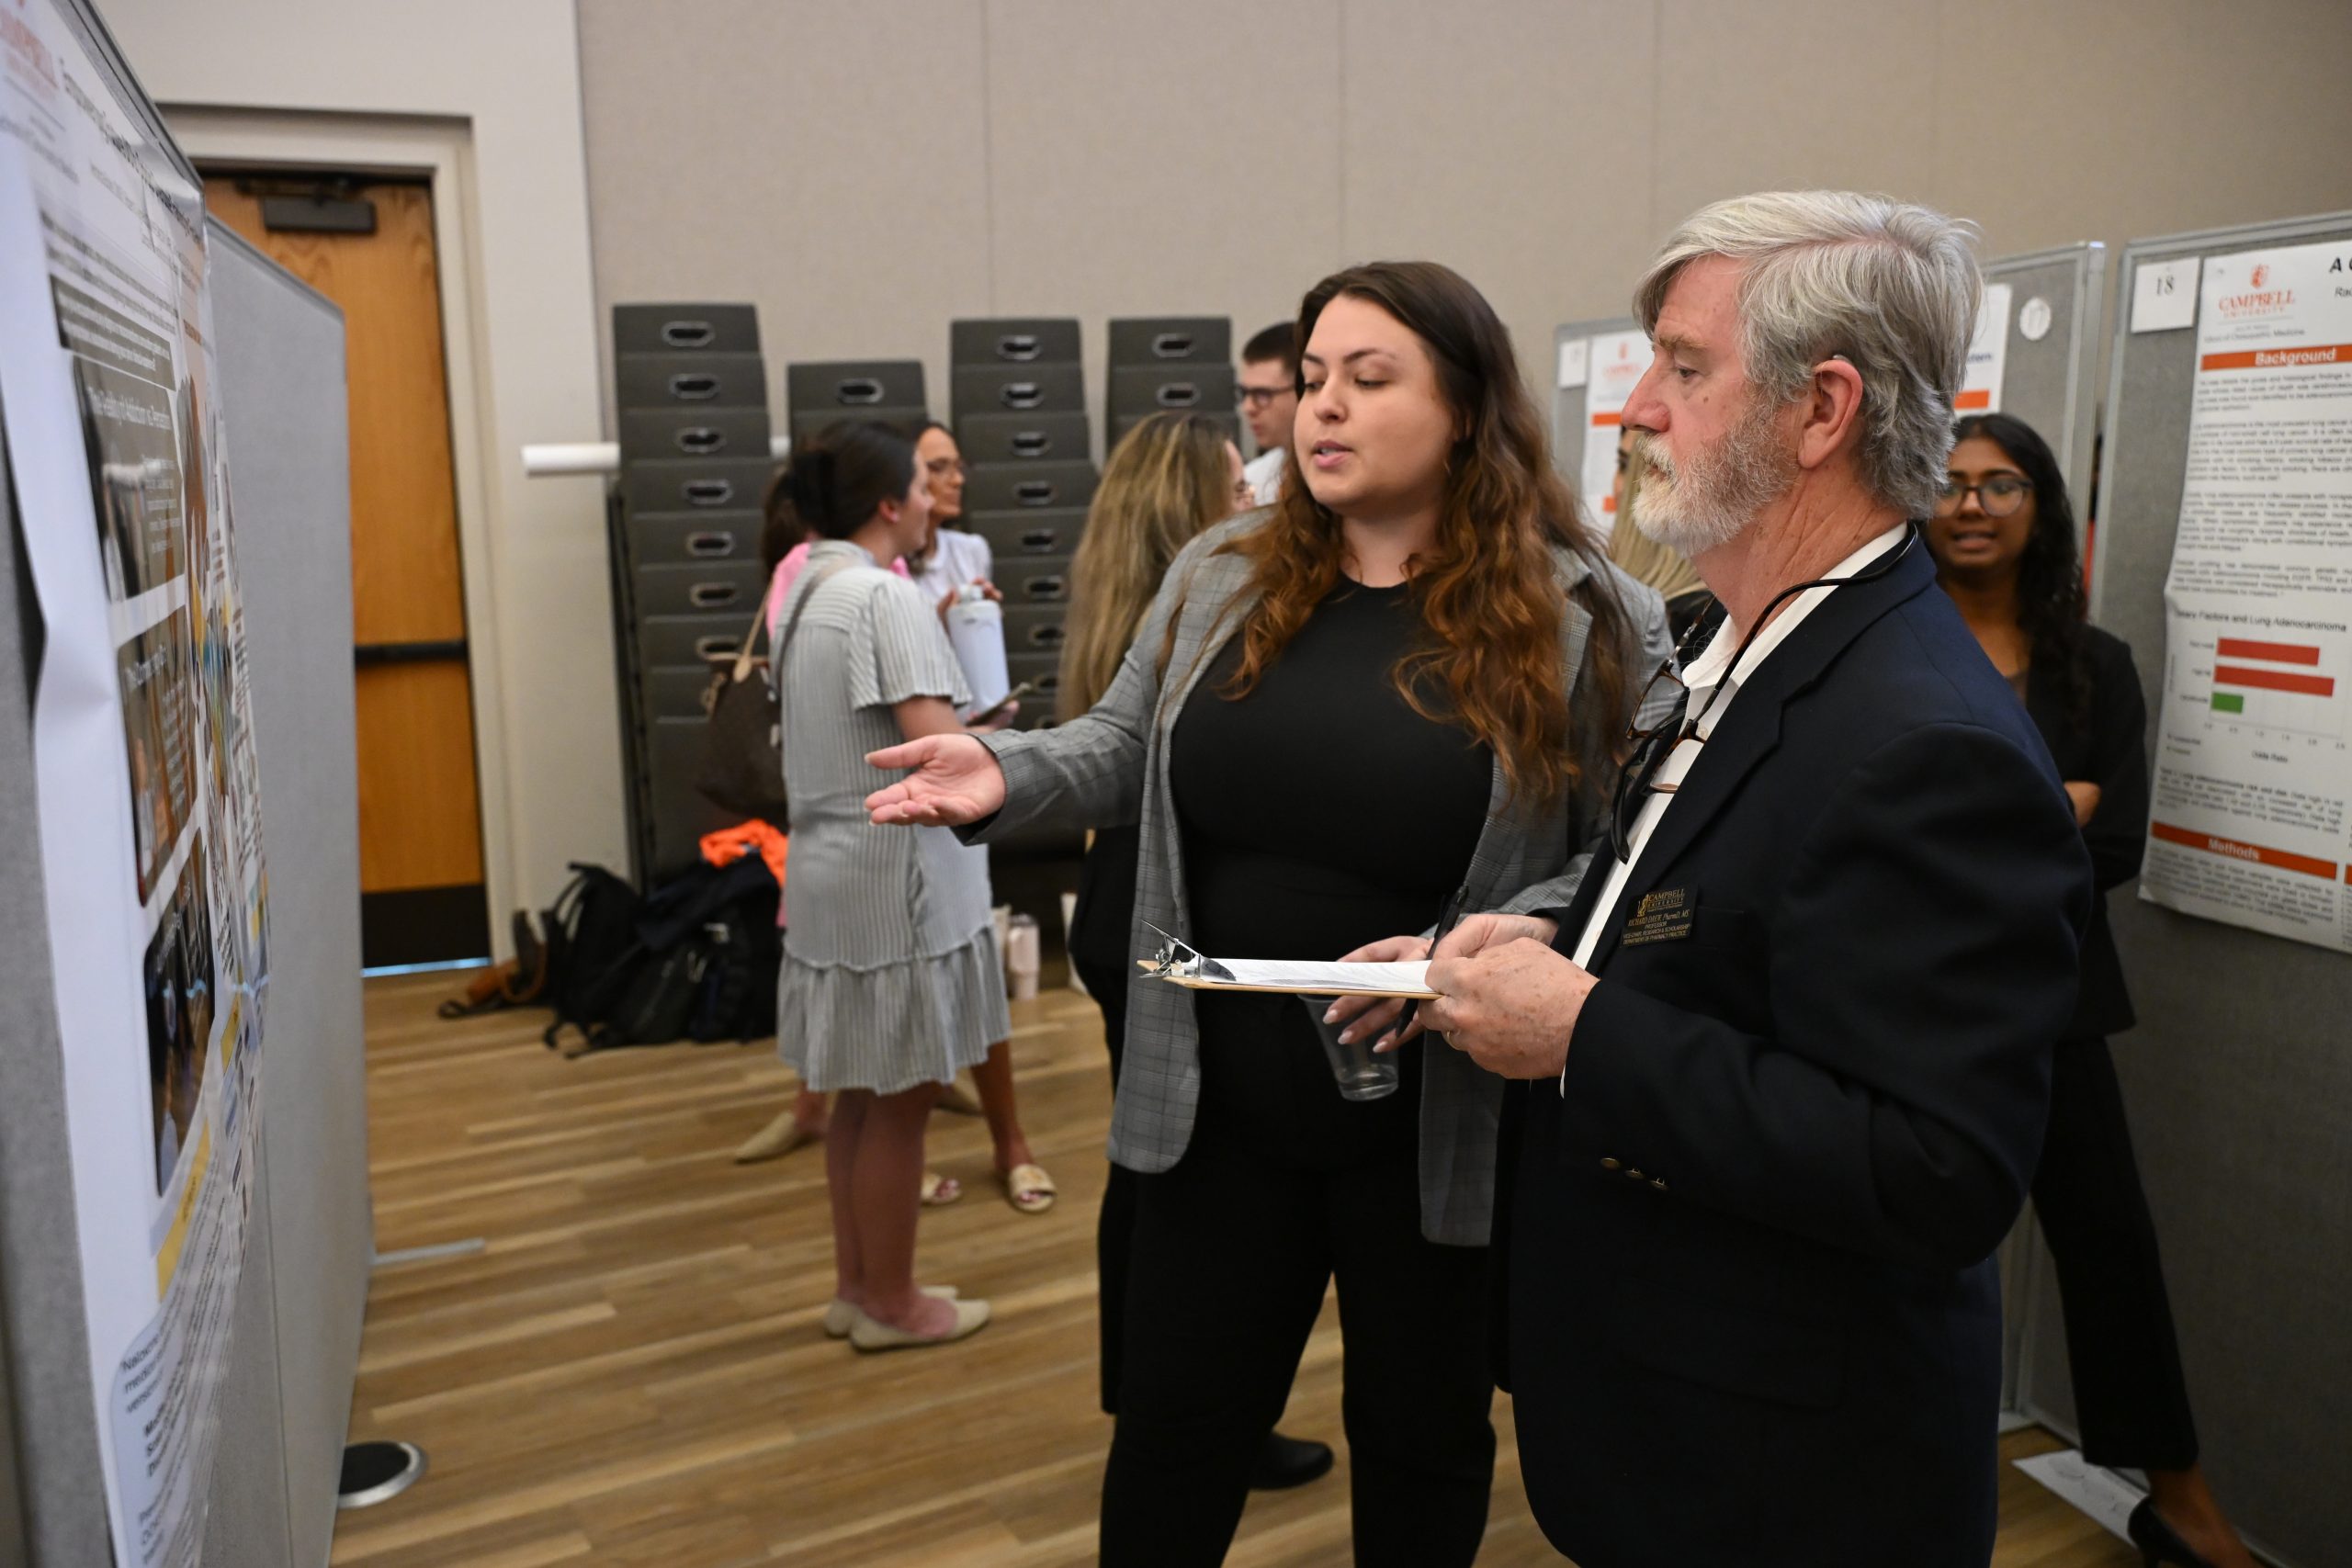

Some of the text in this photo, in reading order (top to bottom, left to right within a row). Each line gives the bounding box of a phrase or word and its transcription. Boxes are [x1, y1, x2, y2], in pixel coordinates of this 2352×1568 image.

[2329, 257, 2342, 273] A
[2157, 275, 2174, 295] 18
[2219, 289, 2295, 310] CAMPBELL
[2255, 347, 2337, 367] Background
[2250, 615, 2271, 627] Lung
[2208, 837, 2260, 861] Methods
[1649, 888, 1685, 901] CAMPBELL
